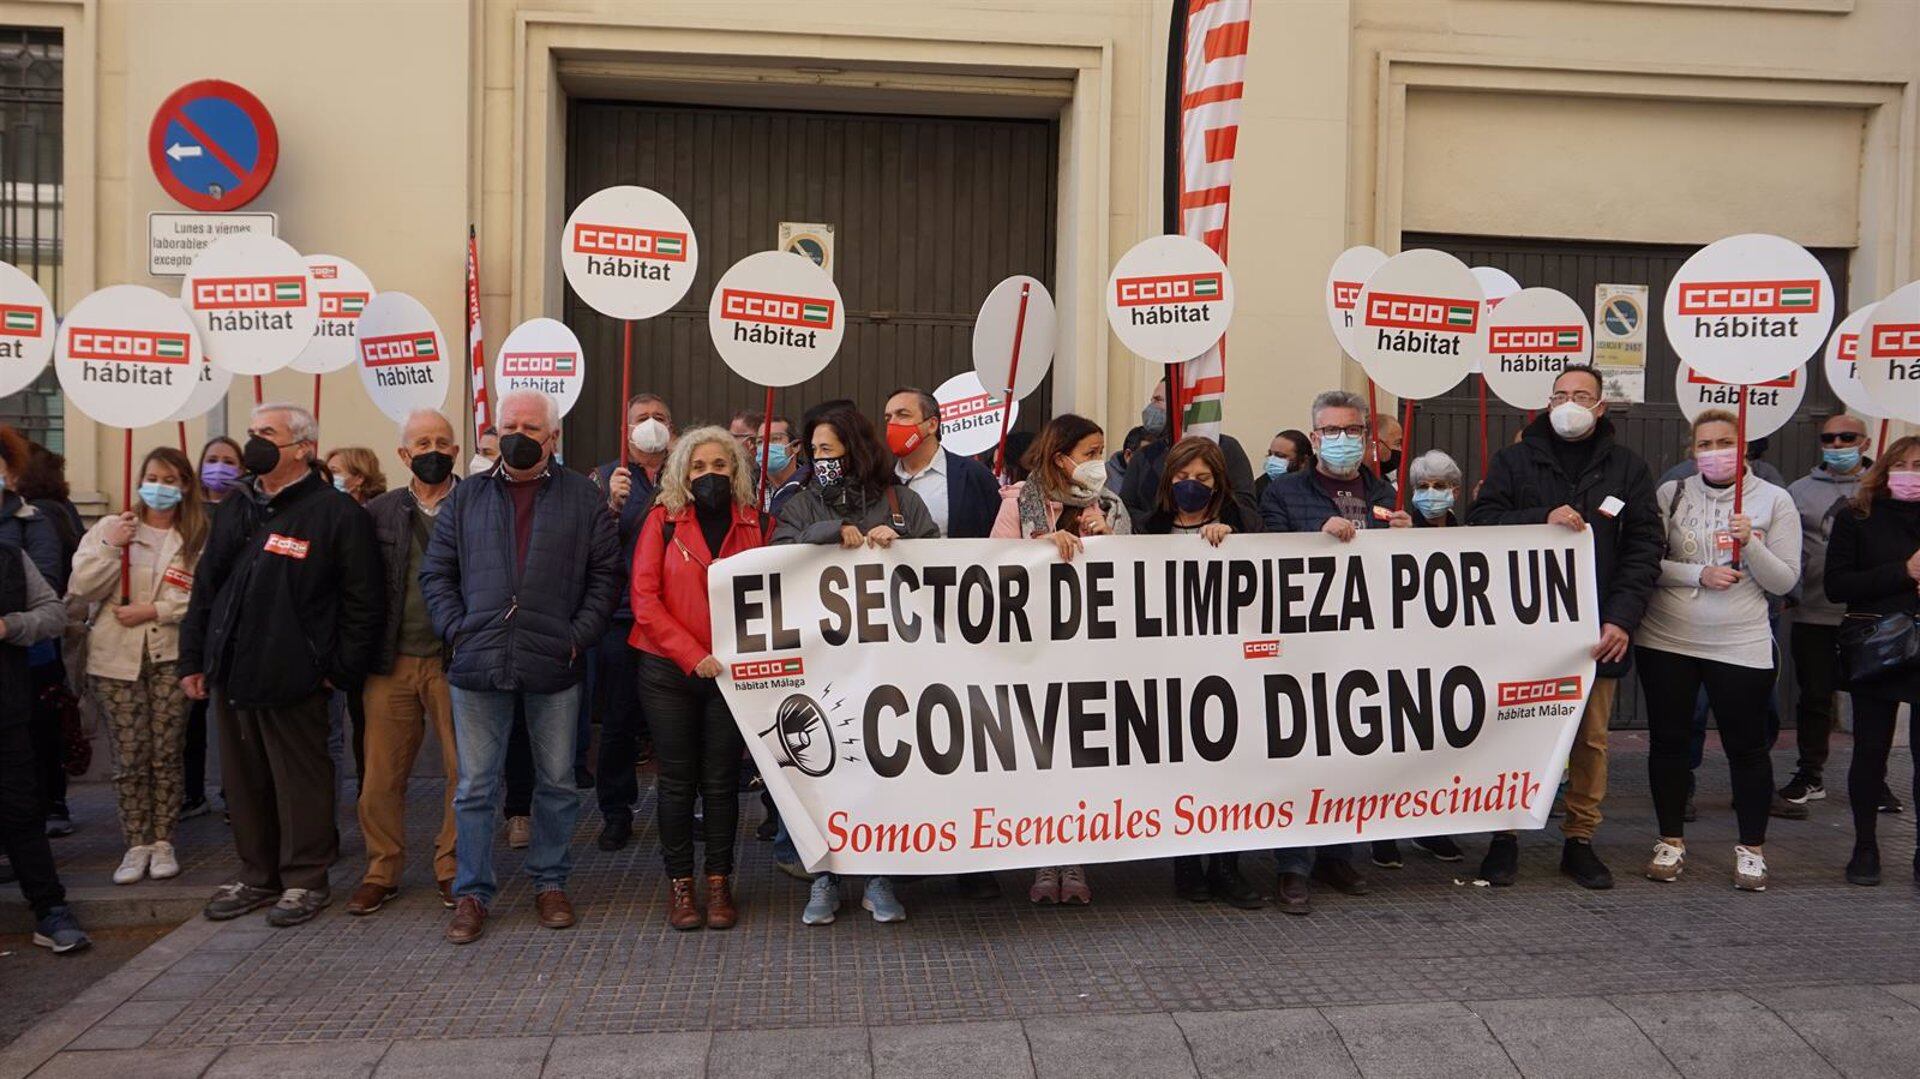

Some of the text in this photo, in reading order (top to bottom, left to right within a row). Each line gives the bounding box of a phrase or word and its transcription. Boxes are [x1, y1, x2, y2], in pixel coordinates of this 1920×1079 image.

[174, 222, 204, 234] Lunes
[207, 224, 212, 234] a
[153, 237, 208, 250] laborables
[579, 230, 652, 253] CCOO
[154, 255, 192, 267] excepto
[587, 256, 671, 281] hábitat
[197, 283, 271, 303] CCOO
[1122, 281, 1189, 301] CCOO
[1685, 288, 1775, 308] CCOO
[727, 296, 799, 320] CCOO
[1131, 304, 1210, 325] hábitat
[1371, 300, 1444, 324] CCOO
[209, 311, 293, 332] hábitat
[313, 320, 355, 337] itat
[1695, 317, 1799, 338] hábitat
[73, 334, 153, 356] CCOO
[734, 322, 816, 349] hábitat
[1377, 329, 1460, 355] hábitat
[1493, 332, 1554, 348] CCOO
[364, 340, 414, 361] CCOO
[83, 361, 173, 386] hábitat
[505, 357, 552, 371] CCOO
[1500, 354, 1569, 372] hábitat
[375, 365, 434, 387] hábitat
[1699, 385, 1779, 407] hábtat
[941, 410, 1001, 435] hábitat
[732, 548, 1580, 654] EL SECTOR DE LIMPIEZA POR UN
[1245, 643, 1277, 653] CCOO
[735, 662, 782, 678] CCOO
[735, 677, 806, 691] hábitat Málaga
[1503, 682, 1557, 701] CCOO
[862, 664, 1487, 779] CONVENIO DIGNO
[1497, 704, 1576, 721] hábitat Mála
[827, 770, 1540, 853] Somos Esenciales Somos Imprescindib
